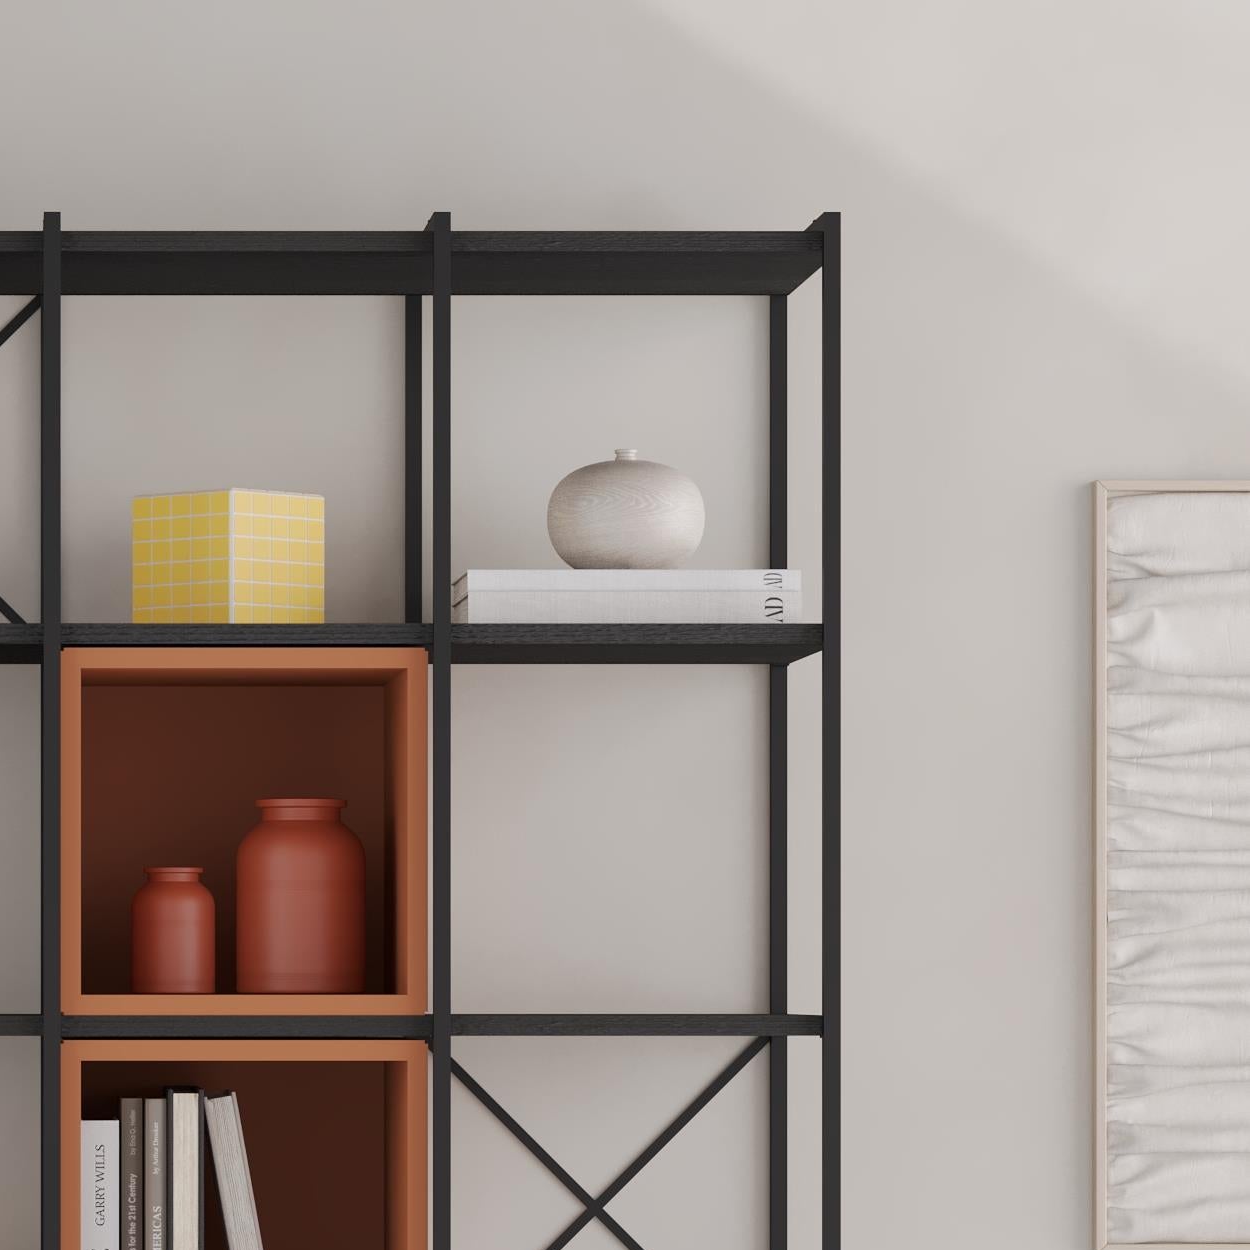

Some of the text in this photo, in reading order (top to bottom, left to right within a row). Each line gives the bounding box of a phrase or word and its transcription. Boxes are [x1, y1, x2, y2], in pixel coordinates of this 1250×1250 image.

[95, 1144, 106, 1183] WILLS
[128, 1173, 138, 1203] Century
[95, 1185, 106, 1227] GARRY
[128, 1205, 137, 1221] 21st
[128, 1222, 137, 1235] the
[128, 1236, 137, 1246] for
